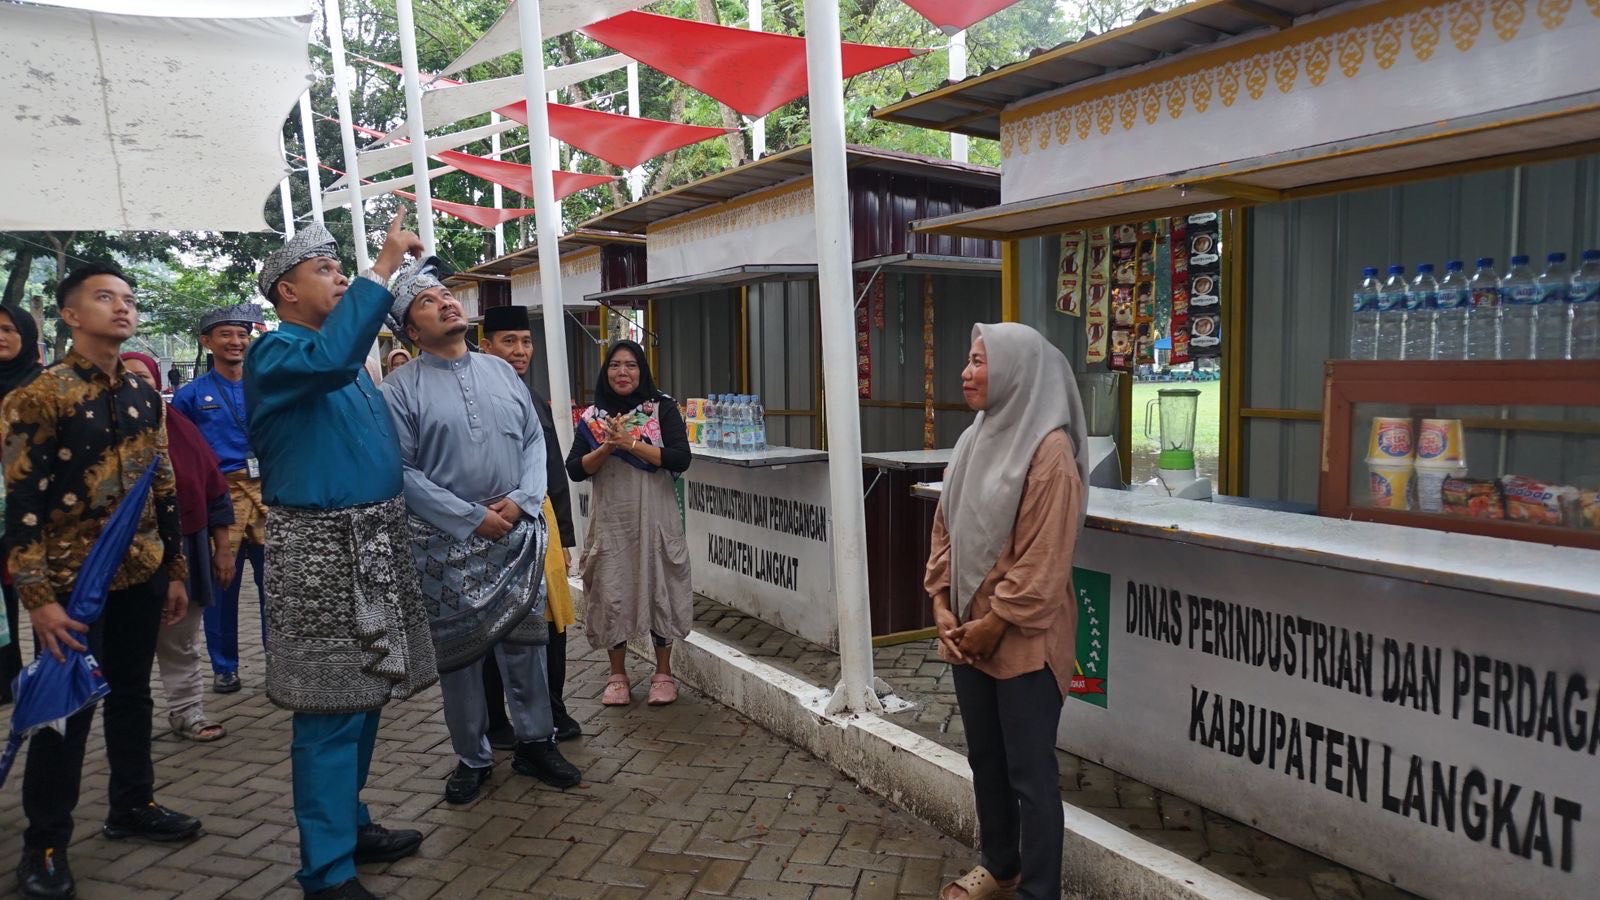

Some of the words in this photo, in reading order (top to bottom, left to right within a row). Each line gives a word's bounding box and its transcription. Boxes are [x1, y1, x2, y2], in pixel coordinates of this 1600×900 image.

[688, 481, 705, 513] DINAS
[705, 485, 753, 524] PERINDUSTRIAN
[753, 494, 768, 528] DAN
[769, 497, 827, 542] PERDAGANGAN
[708, 533, 753, 578] KABUPATEN
[755, 547, 799, 592] LANGKAT
[1126, 581, 1182, 645] DINAS
[1187, 594, 1374, 697] PERINDUSTRIAN
[1382, 638, 1441, 715] DAN
[1189, 685, 1370, 803] KABUPATEN
[1382, 743, 1582, 873] LANGKAT
